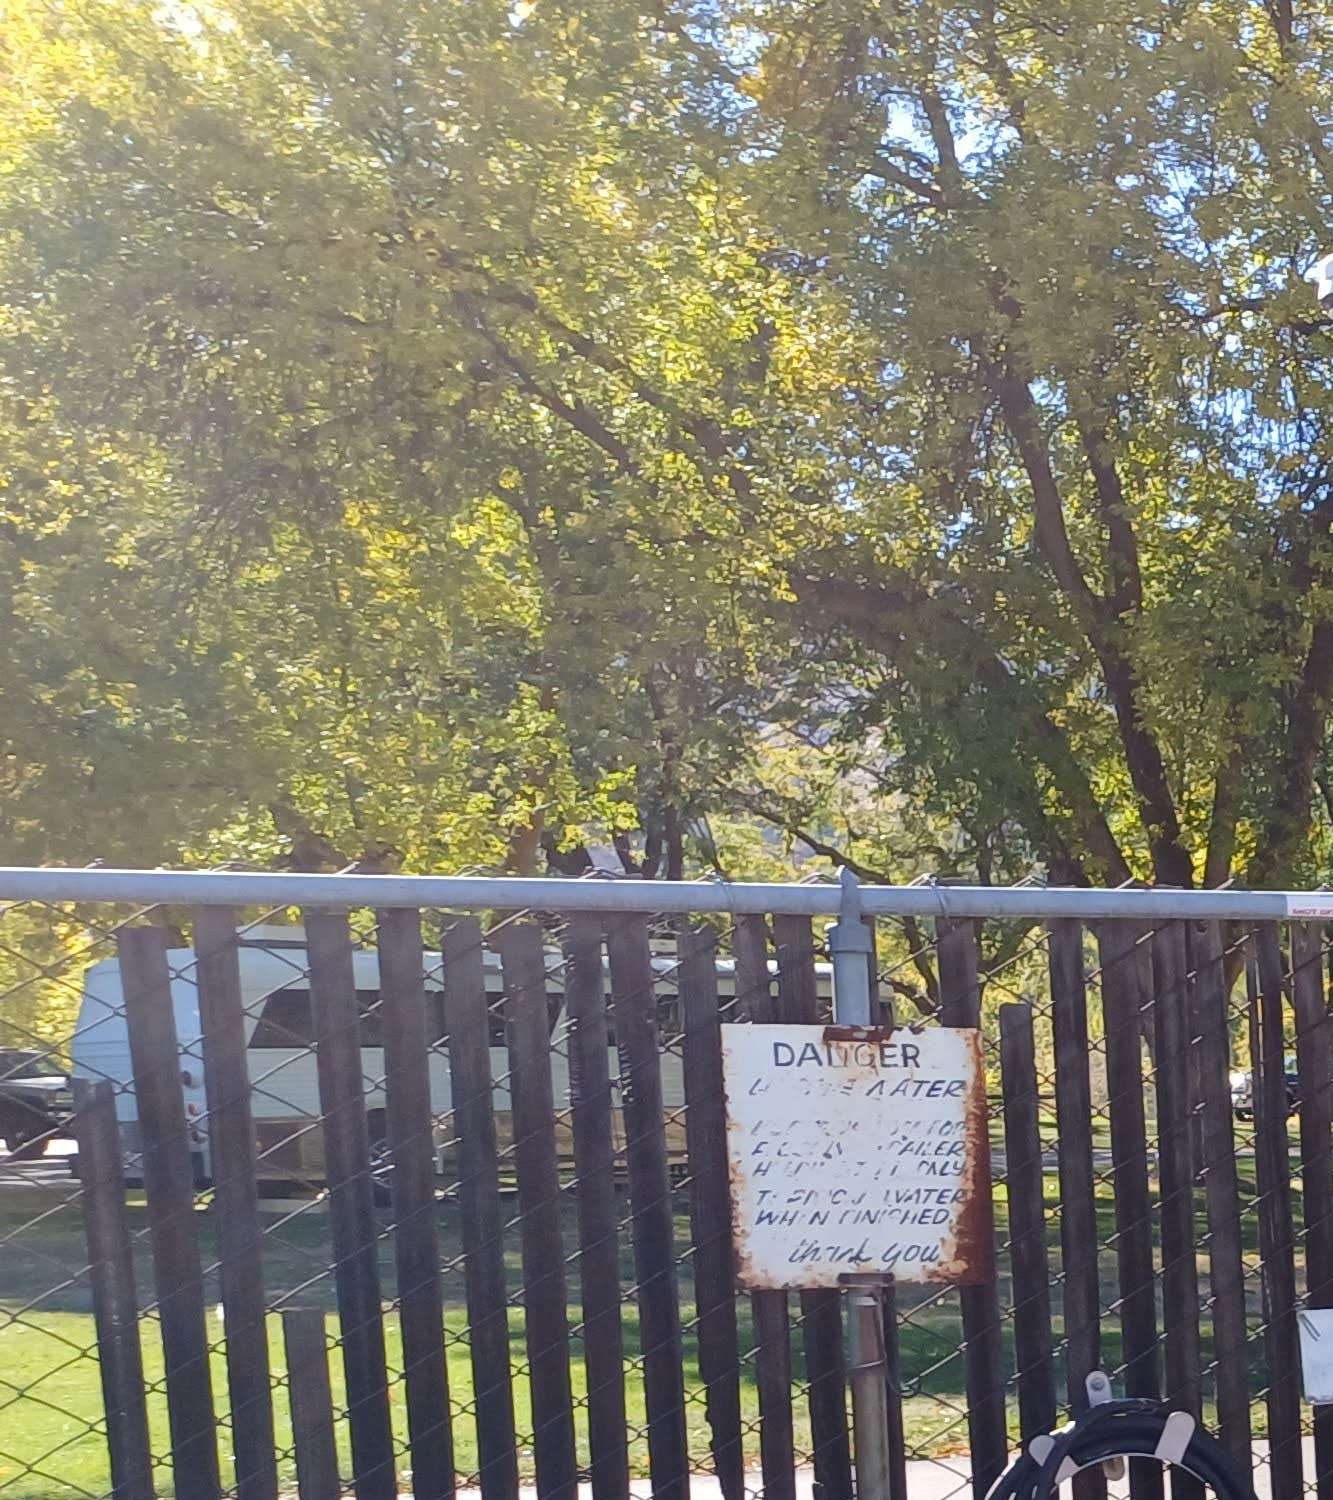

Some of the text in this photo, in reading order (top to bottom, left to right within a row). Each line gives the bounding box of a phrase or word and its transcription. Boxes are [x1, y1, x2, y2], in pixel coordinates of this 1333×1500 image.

[773, 1041, 921, 1068] DANGER
[884, 1187, 967, 1205] WATER
[755, 1208, 830, 1226] WHN
